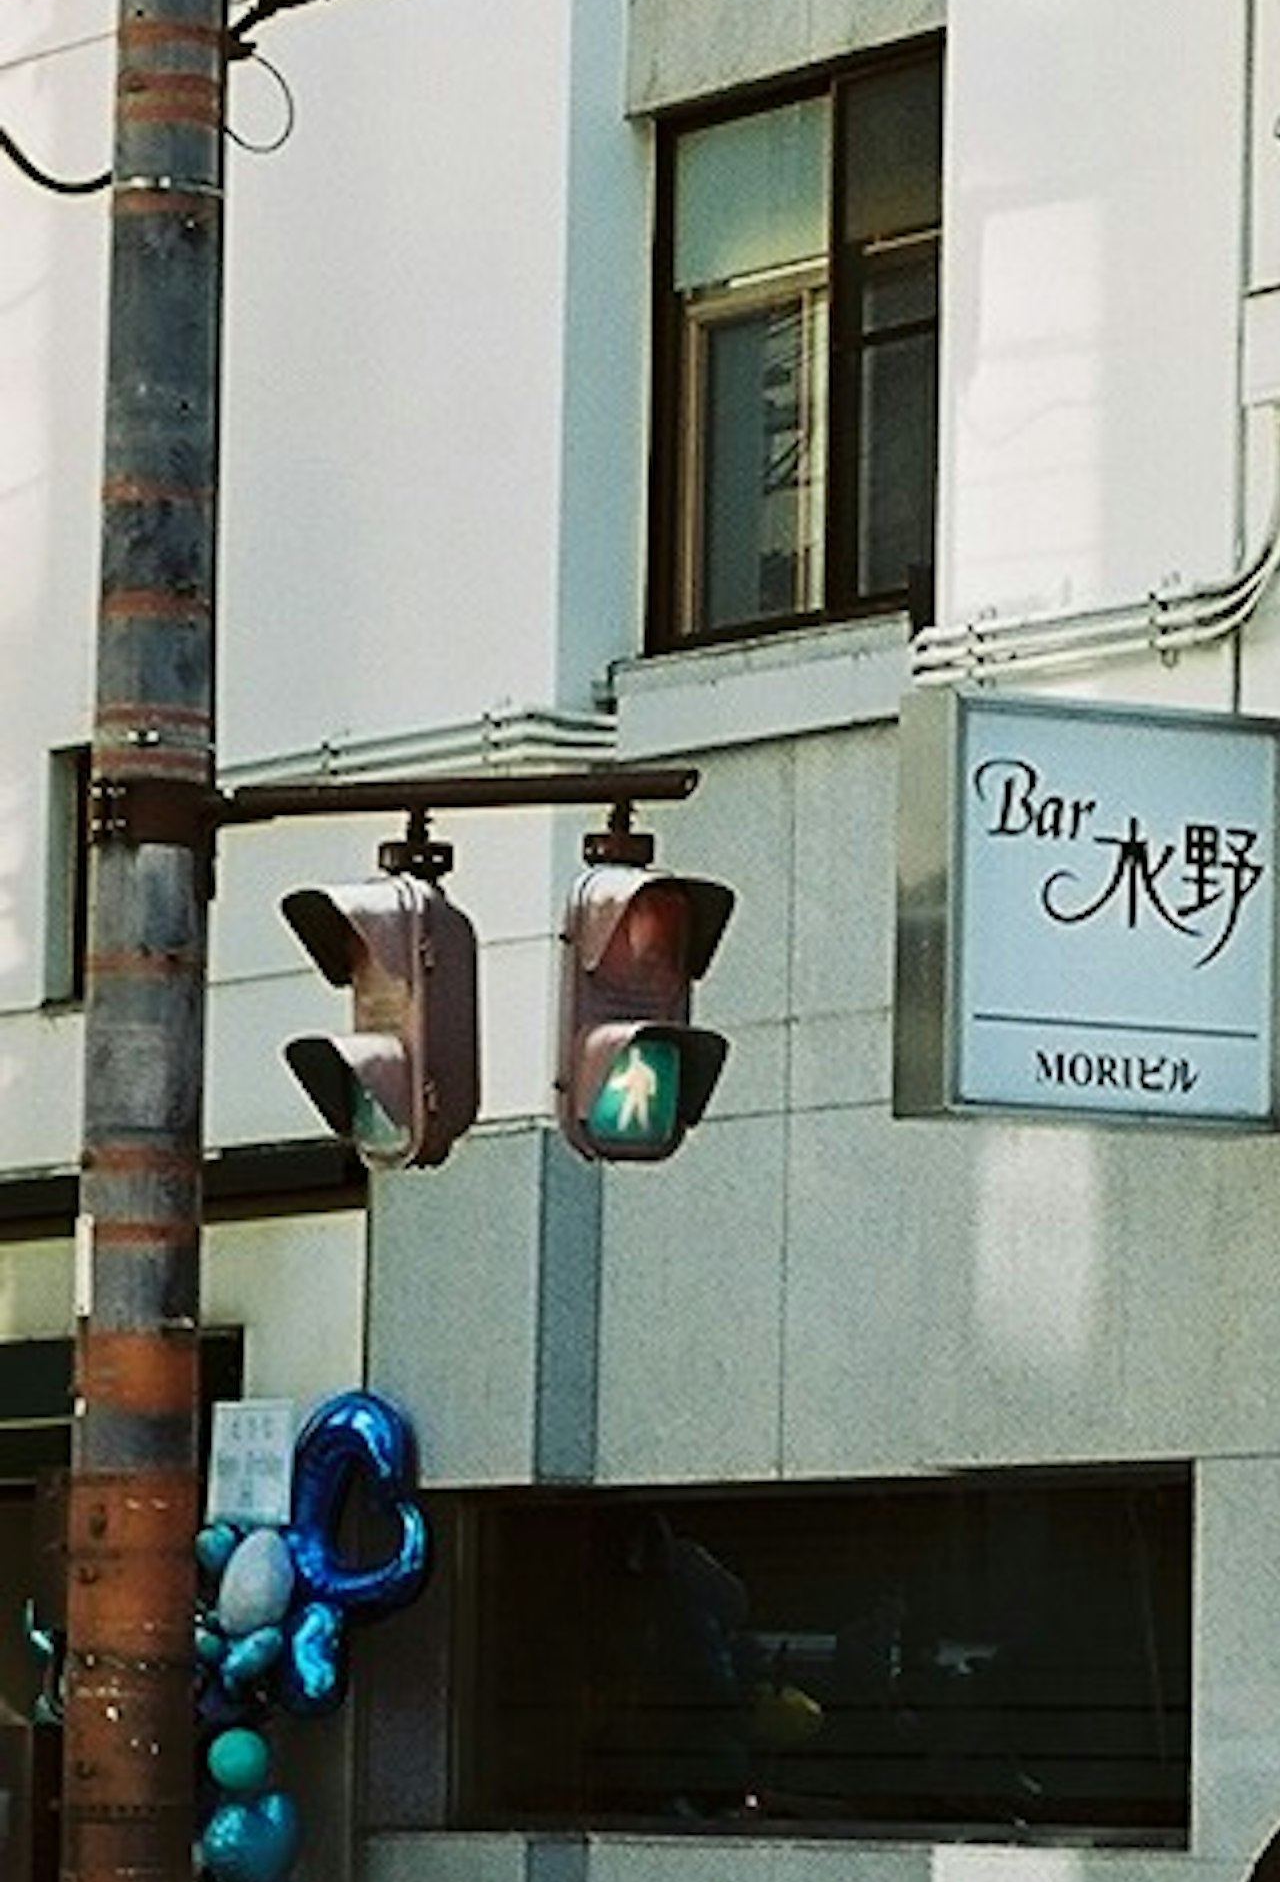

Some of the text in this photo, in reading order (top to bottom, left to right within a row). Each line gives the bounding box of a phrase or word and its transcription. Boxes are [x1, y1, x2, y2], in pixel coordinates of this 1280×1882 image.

[974, 758, 1096, 840] Bar
[1042, 817, 1264, 970] 水野
[1035, 1051, 1199, 1094] MORIビル
